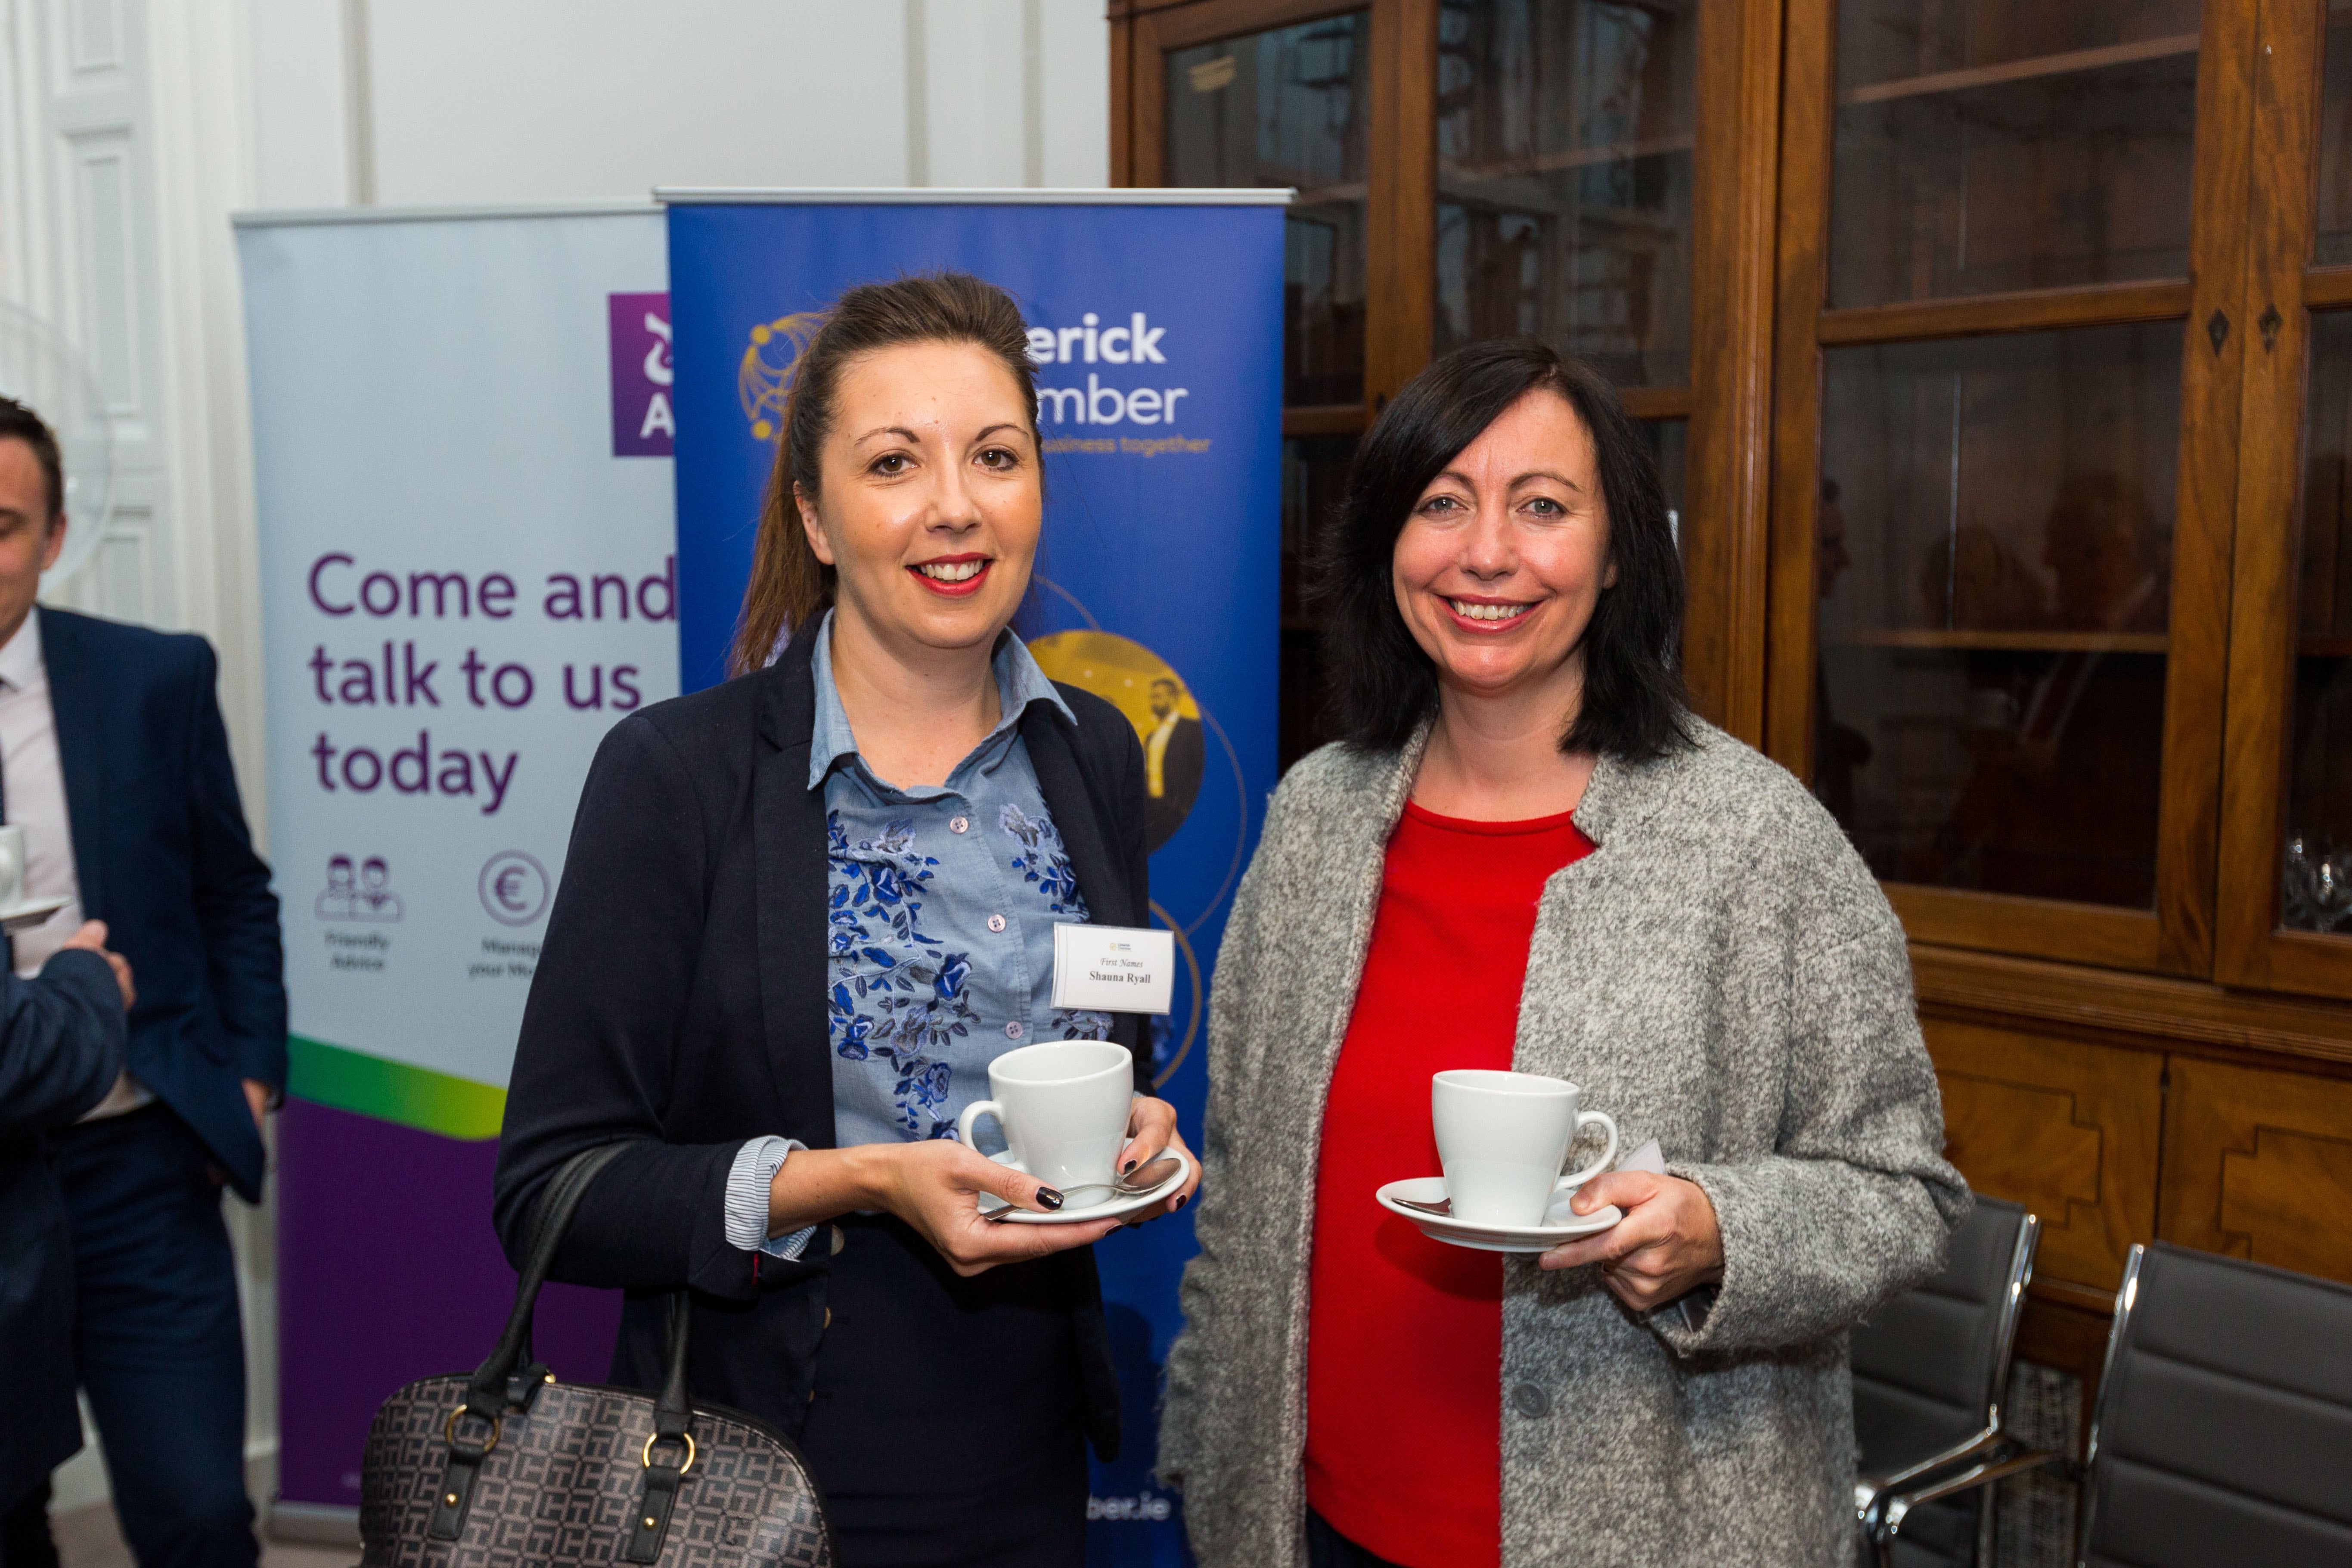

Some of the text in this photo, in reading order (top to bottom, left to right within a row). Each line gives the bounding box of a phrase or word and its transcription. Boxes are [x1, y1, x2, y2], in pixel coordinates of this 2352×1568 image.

[1025, 312, 1166, 364] erick
[1036, 373, 1189, 425] mber
[1042, 435, 1210, 458] usiness together
[307, 551, 677, 623] Come and
[308, 640, 642, 712] talk to us
[310, 729, 519, 817] today
[1089, 971, 1151, 985] Shauna Ryall
[1100, 958, 1143, 968] First Names
[1086, 1491, 1170, 1520] ber.ie
